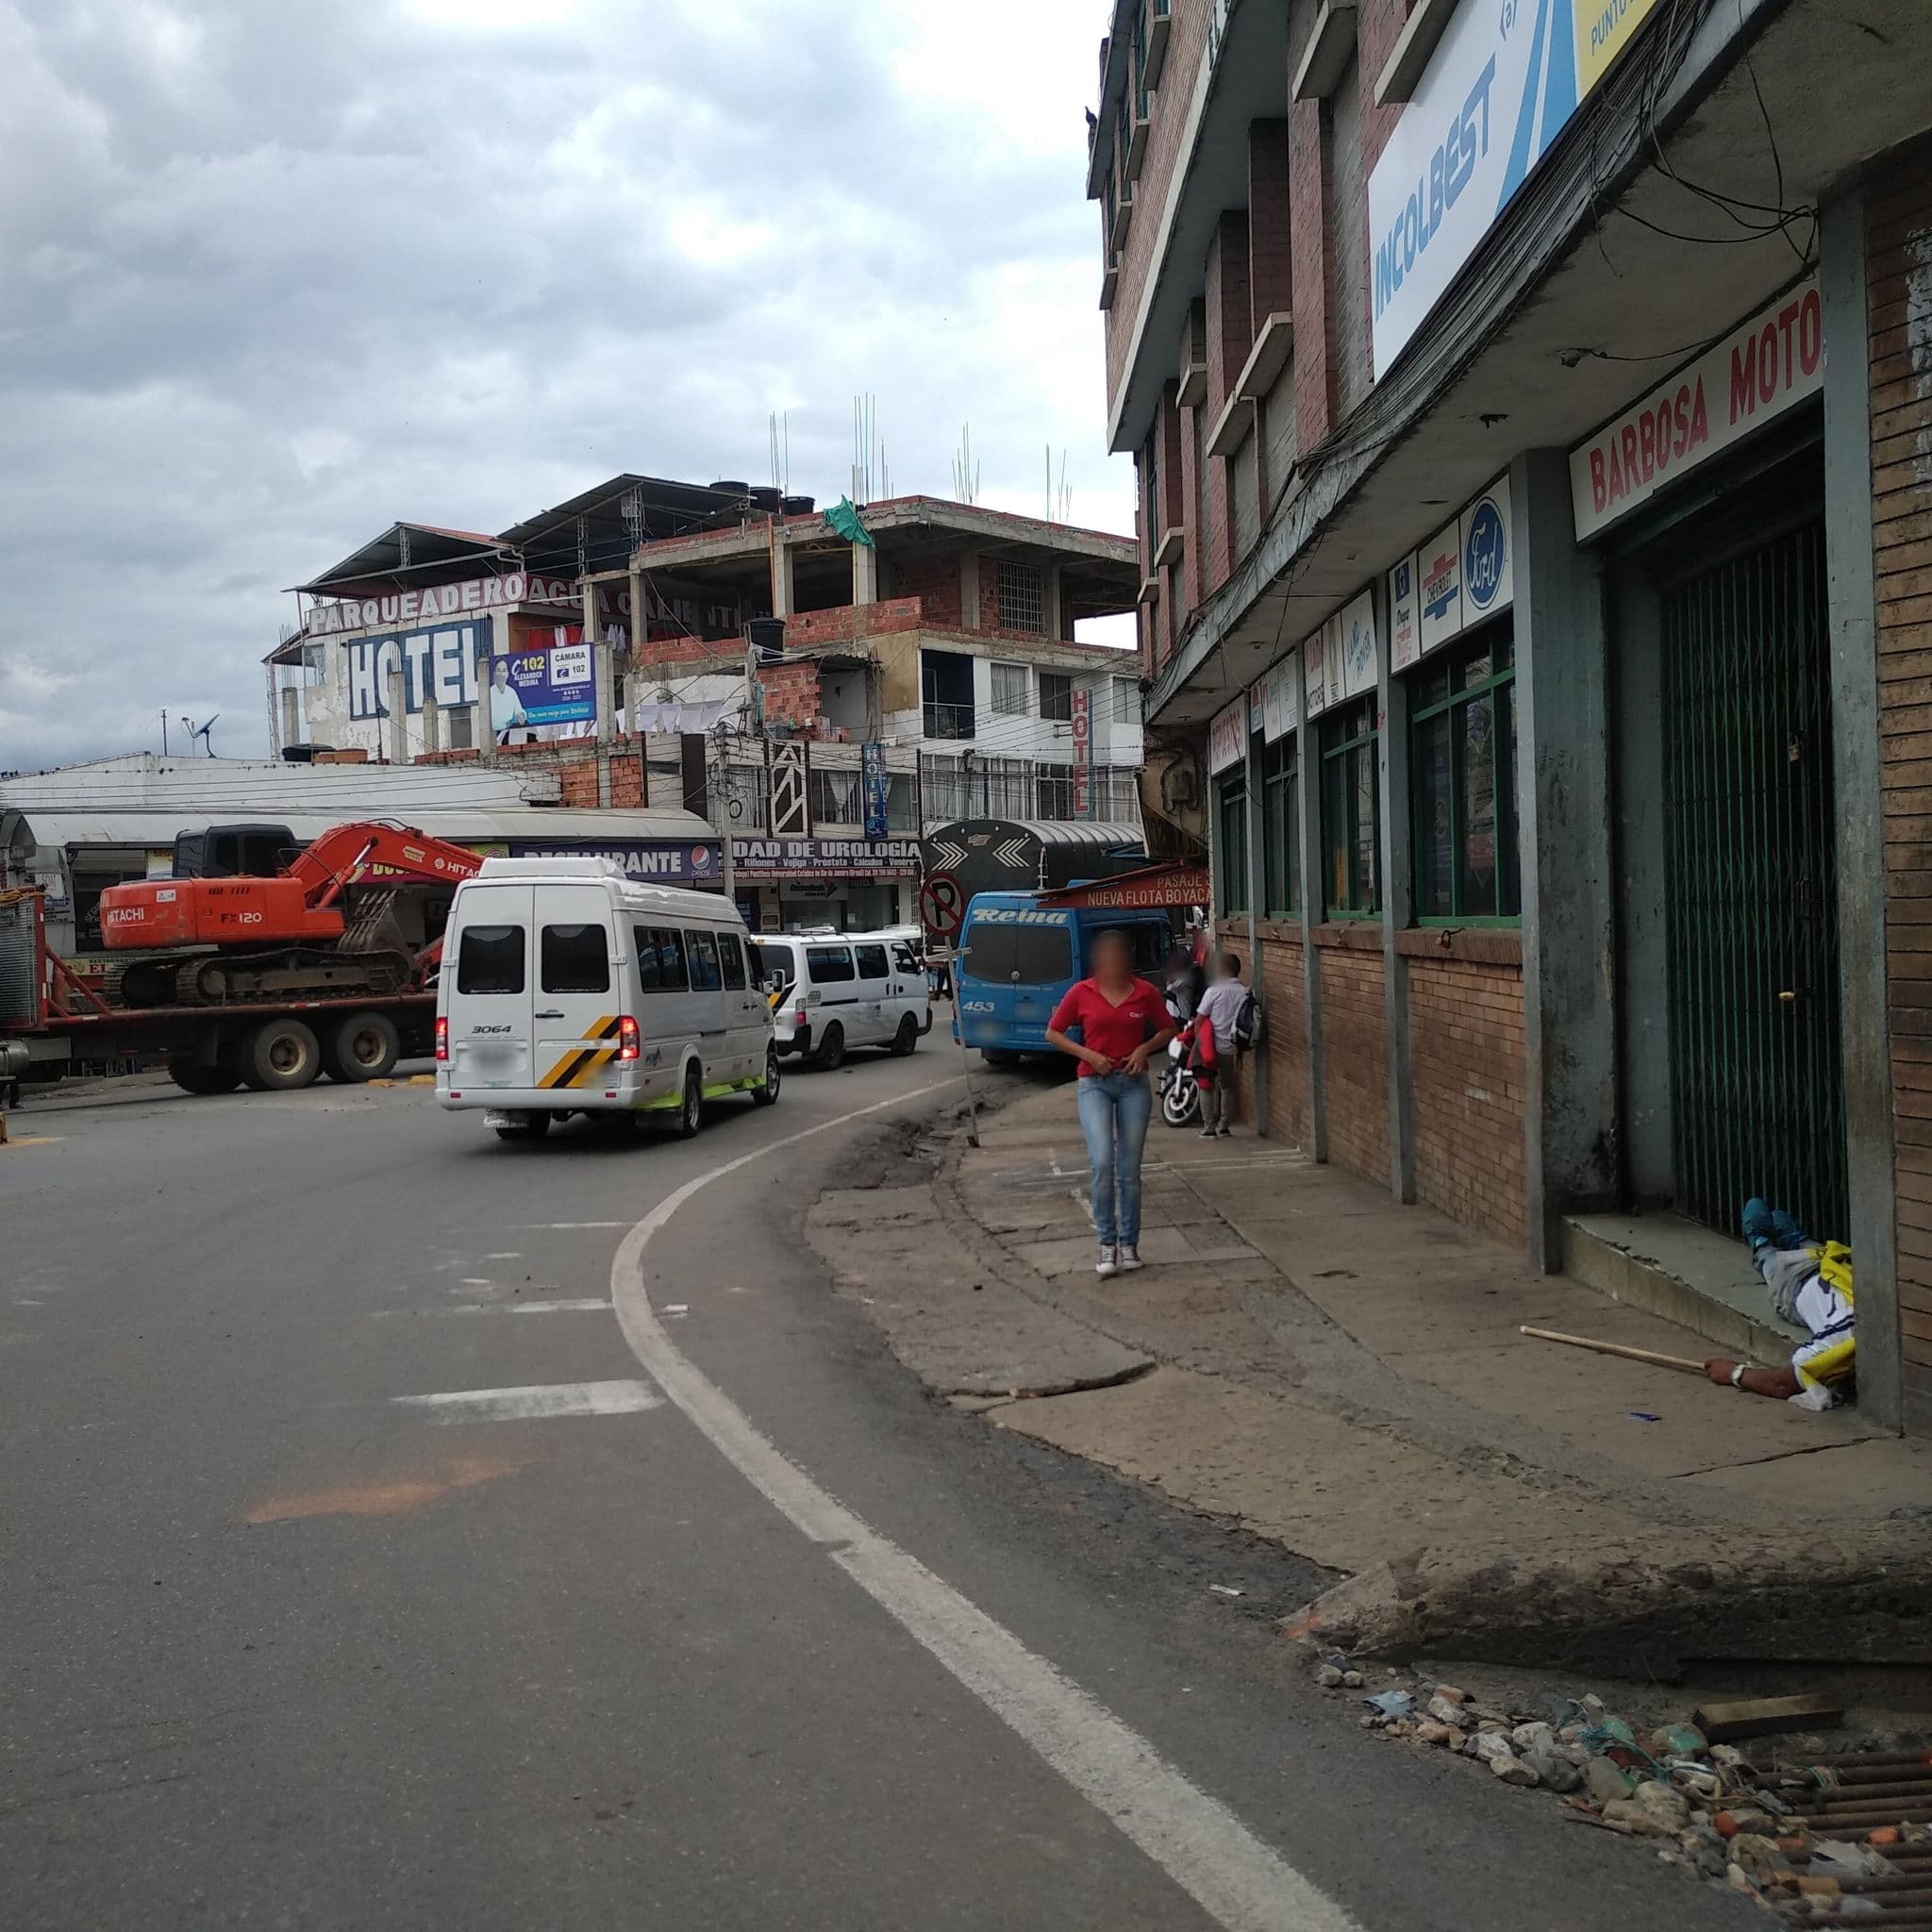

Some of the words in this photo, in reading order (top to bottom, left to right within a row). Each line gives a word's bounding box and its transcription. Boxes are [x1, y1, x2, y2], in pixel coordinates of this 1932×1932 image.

[1374, 52, 1496, 323] INCOLBEST
[1590, 373, 1709, 514] BARBOSA
[1729, 289, 1822, 425] MOTO
[1469, 521, 1499, 590] Ford
[309, 575, 524, 633] PARQUEADERO
[1426, 570, 1452, 604] CHEVROLET
[350, 626, 479, 717] HOTEL
[572, 665, 586, 674] 102
[1073, 689, 1089, 812] HOTEL
[866, 747, 880, 818] HOTEL
[788, 842, 815, 858] DE
[821, 841, 921, 858] UROLOGÍA
[1087, 891, 1124, 906] NUEVA
[1125, 889, 1163, 905] FLOTA
[107, 908, 144, 924] HITACHI
[973, 908, 1069, 924] Reina
[962, 1001, 995, 1011] 453
[472, 1024, 512, 1034] 3064
